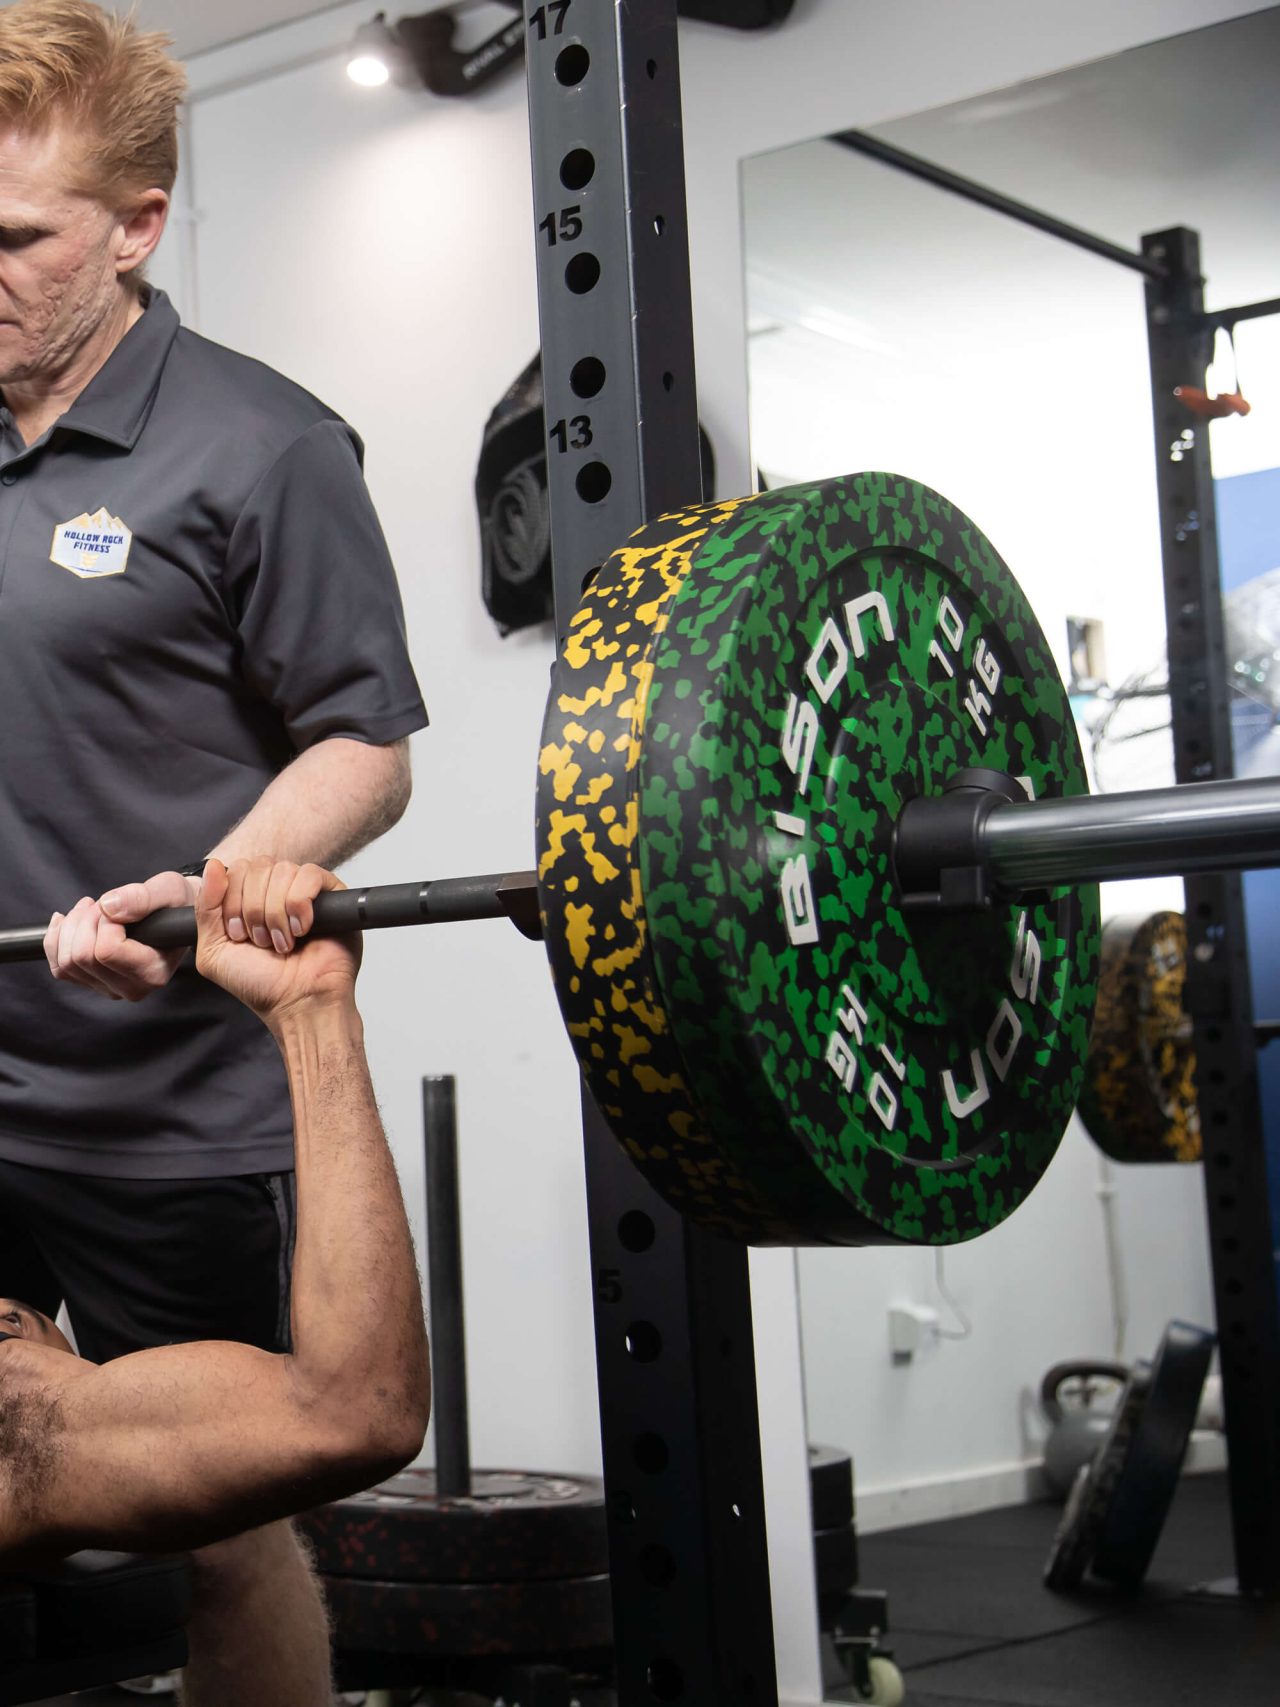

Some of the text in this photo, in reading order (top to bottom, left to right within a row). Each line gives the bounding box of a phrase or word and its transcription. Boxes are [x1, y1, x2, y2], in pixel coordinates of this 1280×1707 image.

[529, 0, 569, 40] 17
[539, 204, 583, 247] 15
[549, 414, 593, 454] 13
[64, 530, 124, 545] HOLLOW ROCK
[73, 541, 111, 554] FITNESS
[928, 595, 964, 678] 10
[964, 638, 1002, 737] KG
[772, 590, 895, 946] BISON
[826, 984, 868, 1093] KG
[869, 1042, 906, 1132] 10
[598, 1268, 623, 1304] 5
